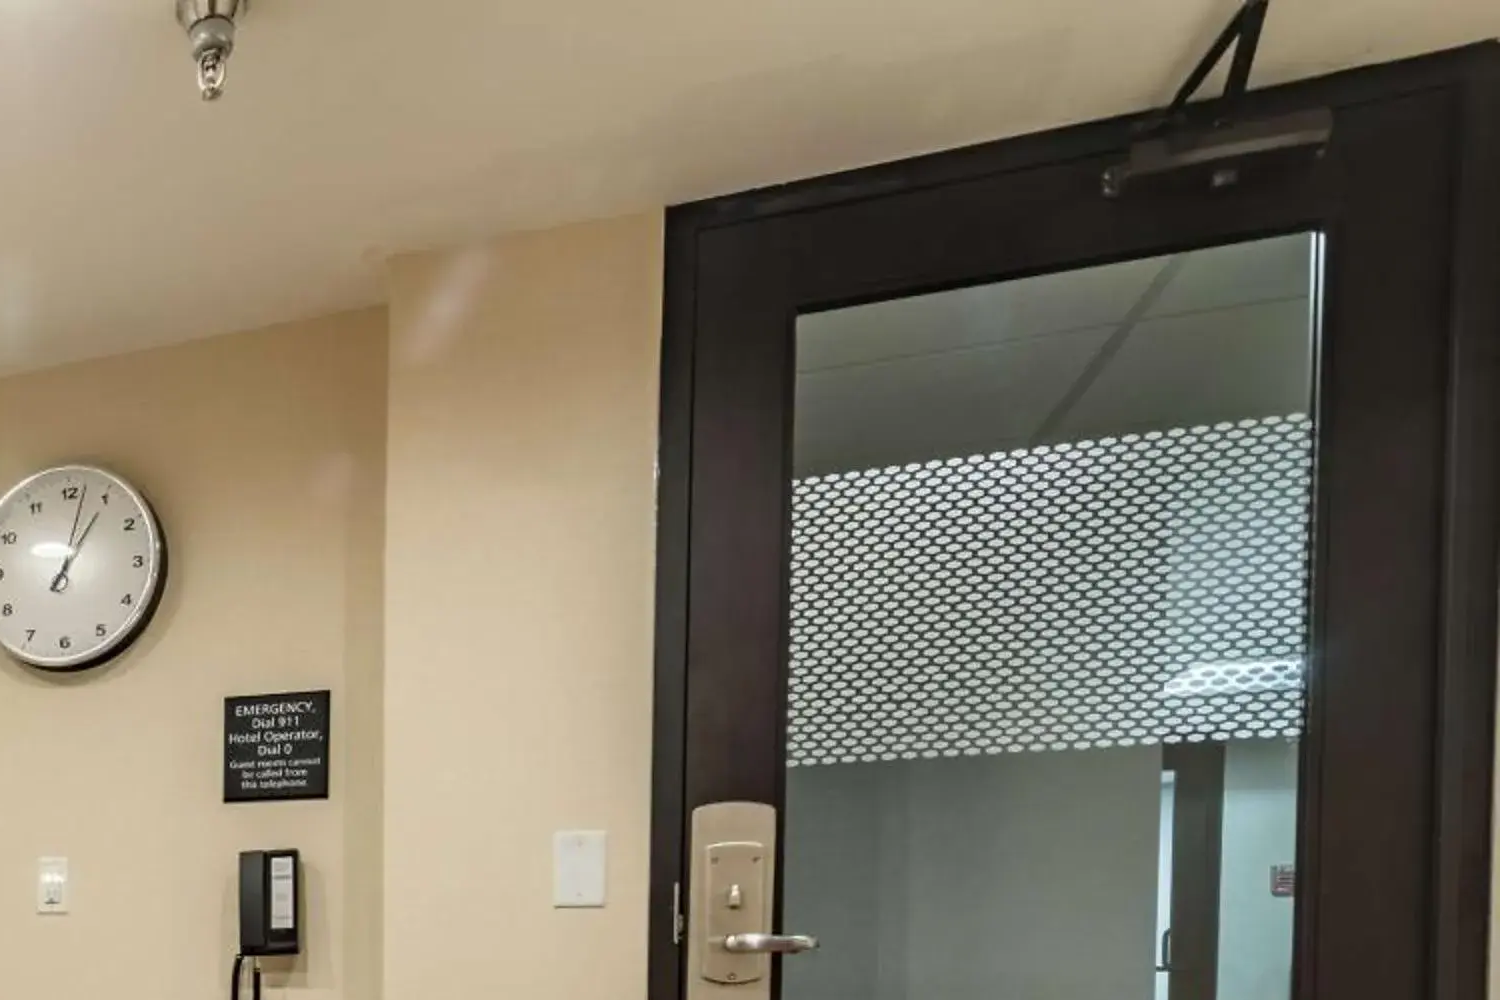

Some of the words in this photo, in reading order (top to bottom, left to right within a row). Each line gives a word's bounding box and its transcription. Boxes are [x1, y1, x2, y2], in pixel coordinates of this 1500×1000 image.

[62, 487, 78, 500] 12
[101, 494, 108, 505] 1
[30, 502, 42, 514] 11
[123, 518, 135, 531] 2
[2, 532, 17, 545] 10
[132, 555, 143, 568] 3
[121, 593, 132, 606] 4
[3, 603, 13, 616] 8
[25, 629, 36, 642] 7
[96, 624, 107, 637] 5
[59, 636, 71, 649] 6
[251, 716, 275, 729] Dial
[278, 716, 299, 727] 911
[228, 733, 261, 744] Hotel
[263, 730, 323, 743] Operator,
[257, 743, 281, 756] Dial
[283, 743, 293, 755] 0
[256, 768, 283, 778] called
